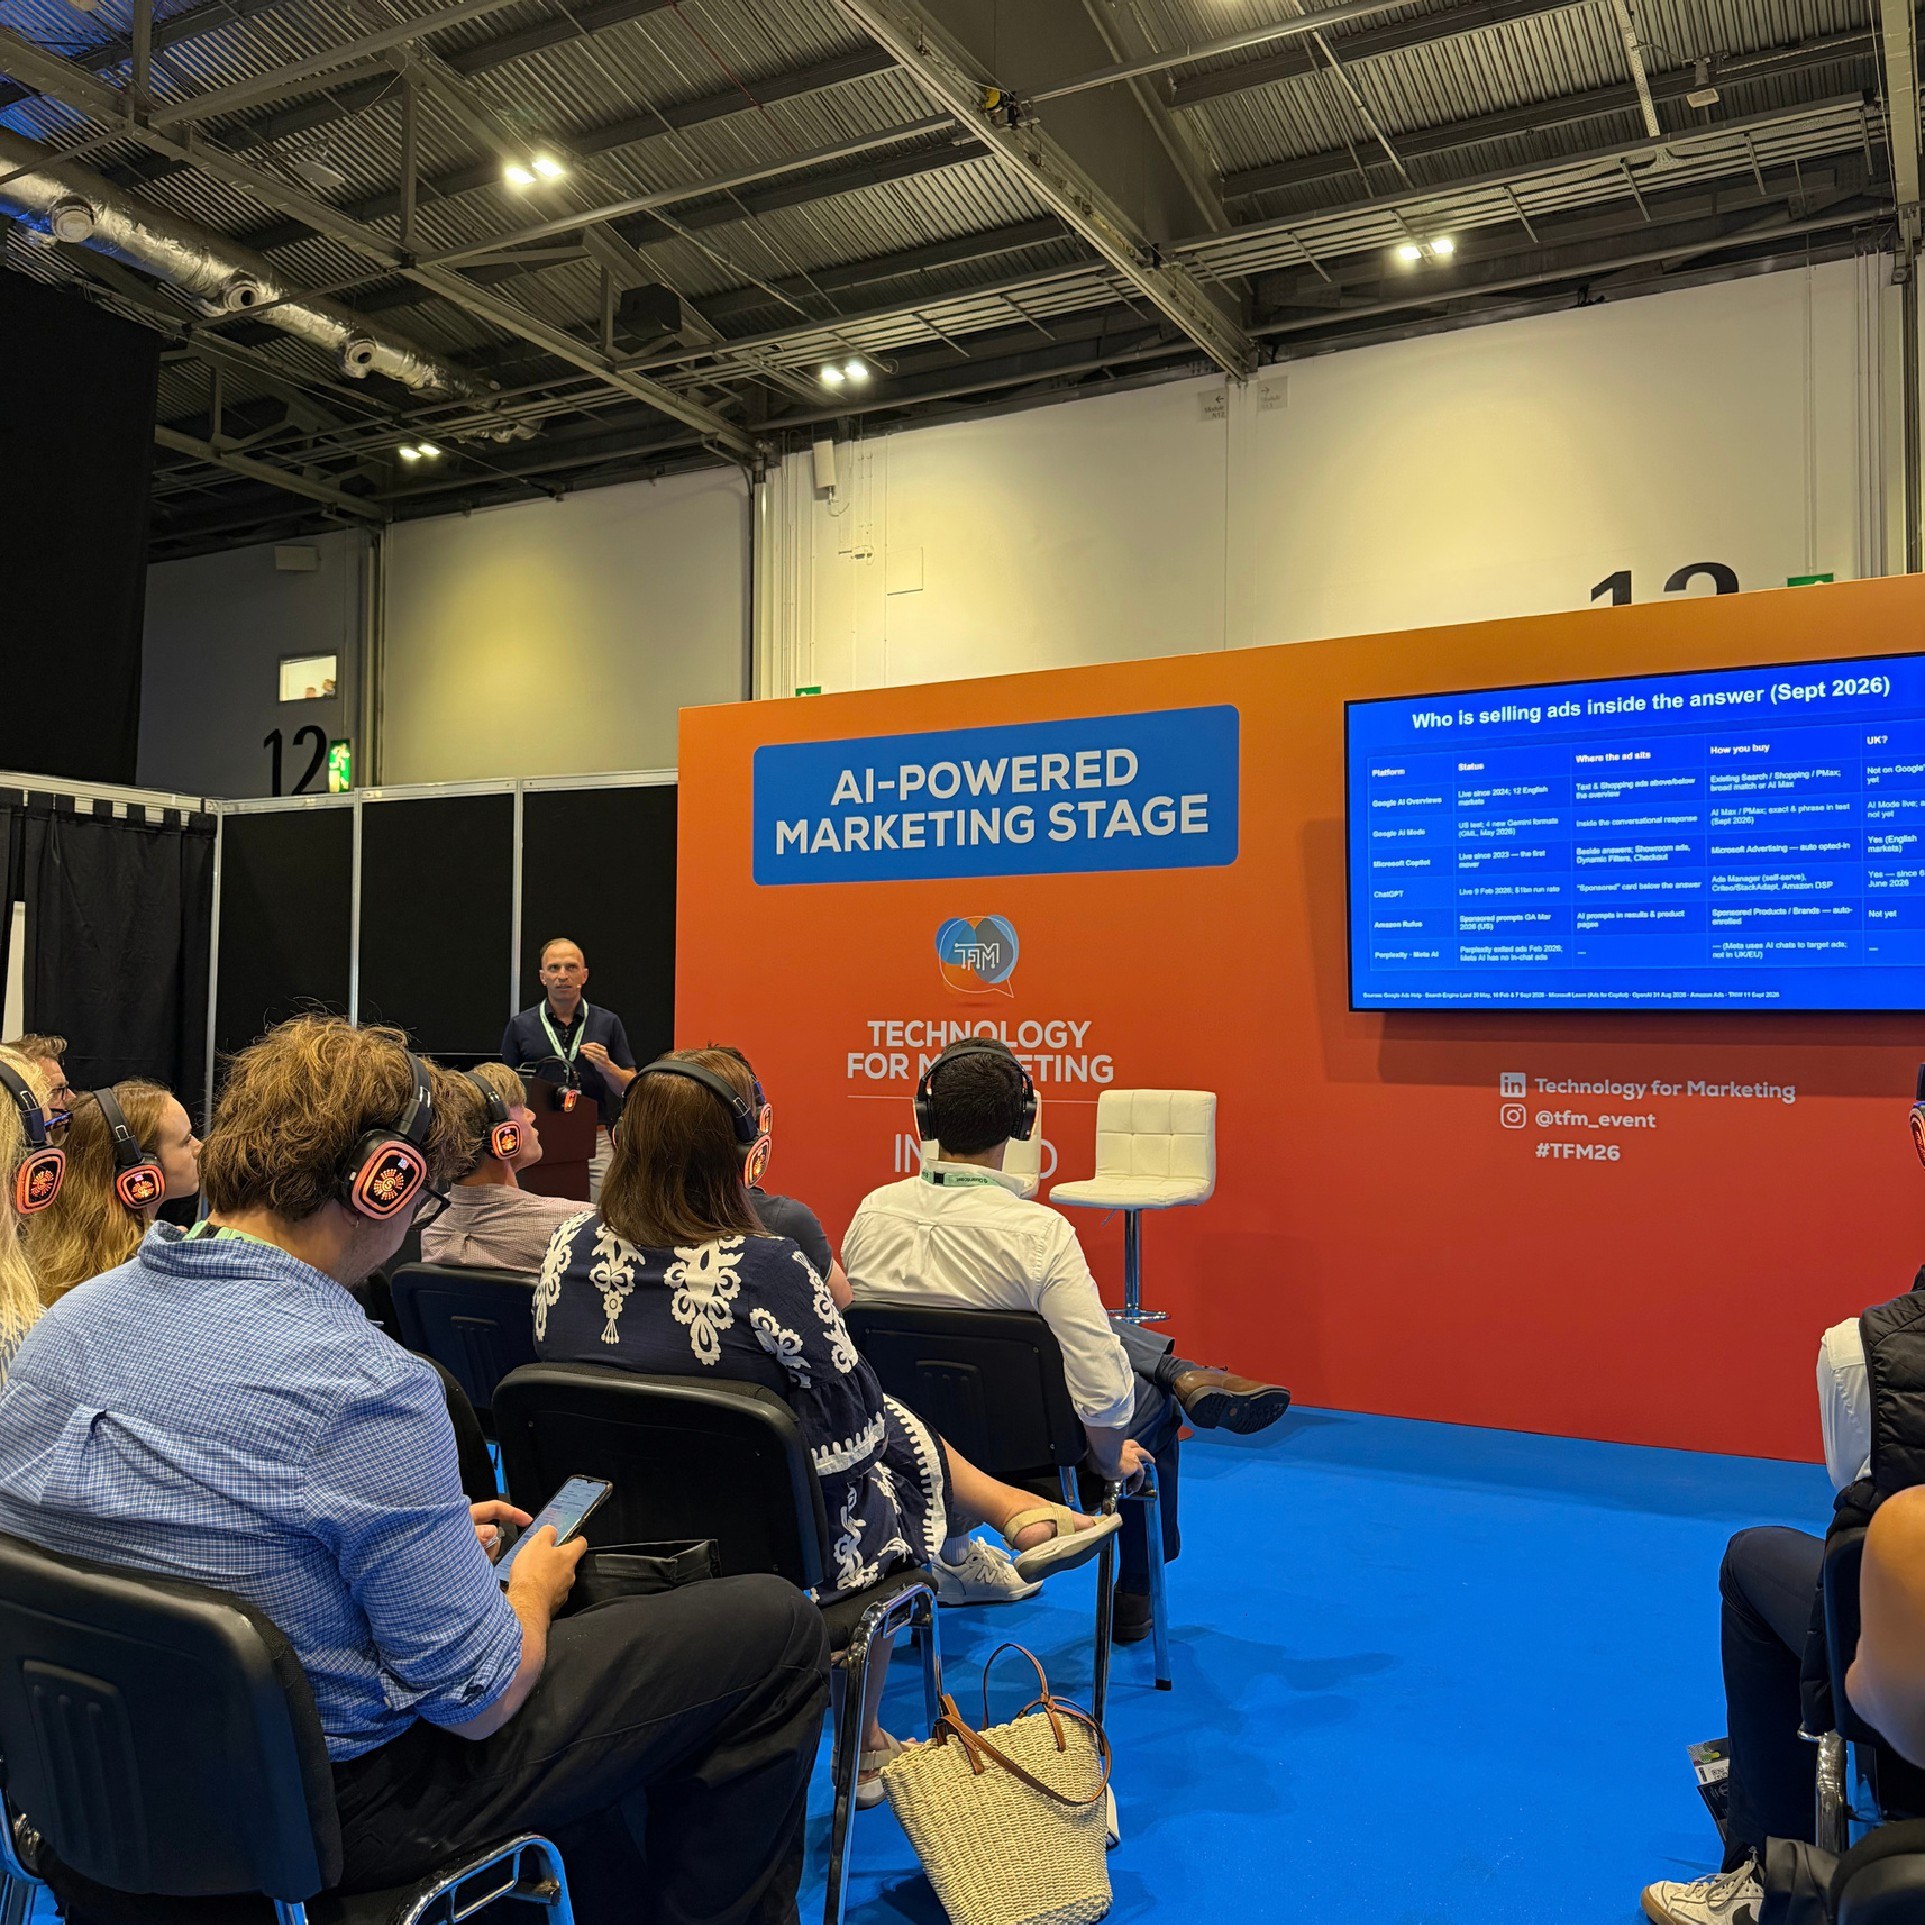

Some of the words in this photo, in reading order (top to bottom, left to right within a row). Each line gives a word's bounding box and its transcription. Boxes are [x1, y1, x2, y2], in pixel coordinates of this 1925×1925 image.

[1413, 713, 1452, 728] Who
[1459, 710, 1474, 725] is
[1480, 706, 1541, 723] selling
[1548, 701, 1580, 717] ads
[1588, 696, 1646, 715] inside
[1652, 693, 1684, 709] the
[1690, 690, 1764, 707] answer
[1771, 682, 1825, 705] (Sept
[1832, 677, 1889, 697] 2026)
[1867, 735, 1888, 745] UK?
[1710, 746, 1731, 754] How
[1733, 746, 1750, 754] you
[1752, 744, 1770, 753] buy
[264, 725, 329, 797] 12
[1576, 755, 1604, 763] Where
[1605, 753, 1620, 761] the
[1622, 752, 1633, 760] ad
[1458, 763, 1484, 771] Status
[1867, 766, 1880, 774] Not
[830, 748, 1138, 806] AI-POWERED
[1372, 769, 1405, 777] Platform
[1710, 775, 1740, 784] Existing
[1741, 773, 1768, 781] Search
[1775, 771, 1809, 780] Shopping
[1600, 781, 1634, 790] Shopping
[1710, 783, 1732, 791] broad
[1734, 782, 1757, 790] match
[1778, 780, 1794, 788] Max
[1523, 787, 1548, 795] English
[1798, 805, 1824, 814] phrase
[1882, 810, 1894, 818] yet
[776, 805, 1034, 855] MARKETING
[1048, 794, 1208, 842] STAGE
[1612, 817, 1662, 825] conversational
[1664, 816, 1697, 824] response
[1712, 818, 1731, 826] (Sept
[1885, 835, 1917, 844] (English
[1635, 845, 1673, 853] Showroom
[1712, 846, 1745, 854] Microsoft
[1746, 845, 1788, 853] Advertising
[1868, 844, 1903, 853] markets)
[1577, 855, 1607, 865] Dynamic
[1634, 853, 1668, 861] Checkout
[1374, 860, 1404, 868] Microsoft
[1727, 875, 1760, 884] Manager
[1815, 881, 1833, 889] DSP
[1374, 890, 1403, 898] ChatGPT
[1657, 910, 1685, 918] product
[1712, 909, 1752, 917] Sponsored
[1793, 907, 1821, 915] Brands
[1885, 910, 1896, 918] yet
[1460, 915, 1495, 923] Sponsored
[1496, 915, 1523, 923] prompts
[1460, 946, 1491, 955] Perplexity
[1807, 942, 1828, 950] target
[954, 942, 1000, 970] TFM
[848, 1052, 910, 1080] FOR
[1534, 1078, 1646, 1100] Technology
[1651, 1080, 1680, 1096] for
[1686, 1080, 1796, 1104] Marketing
[1535, 1110, 1656, 1128] @tfm_event
[1535, 1143, 1621, 1161] #TFM26
